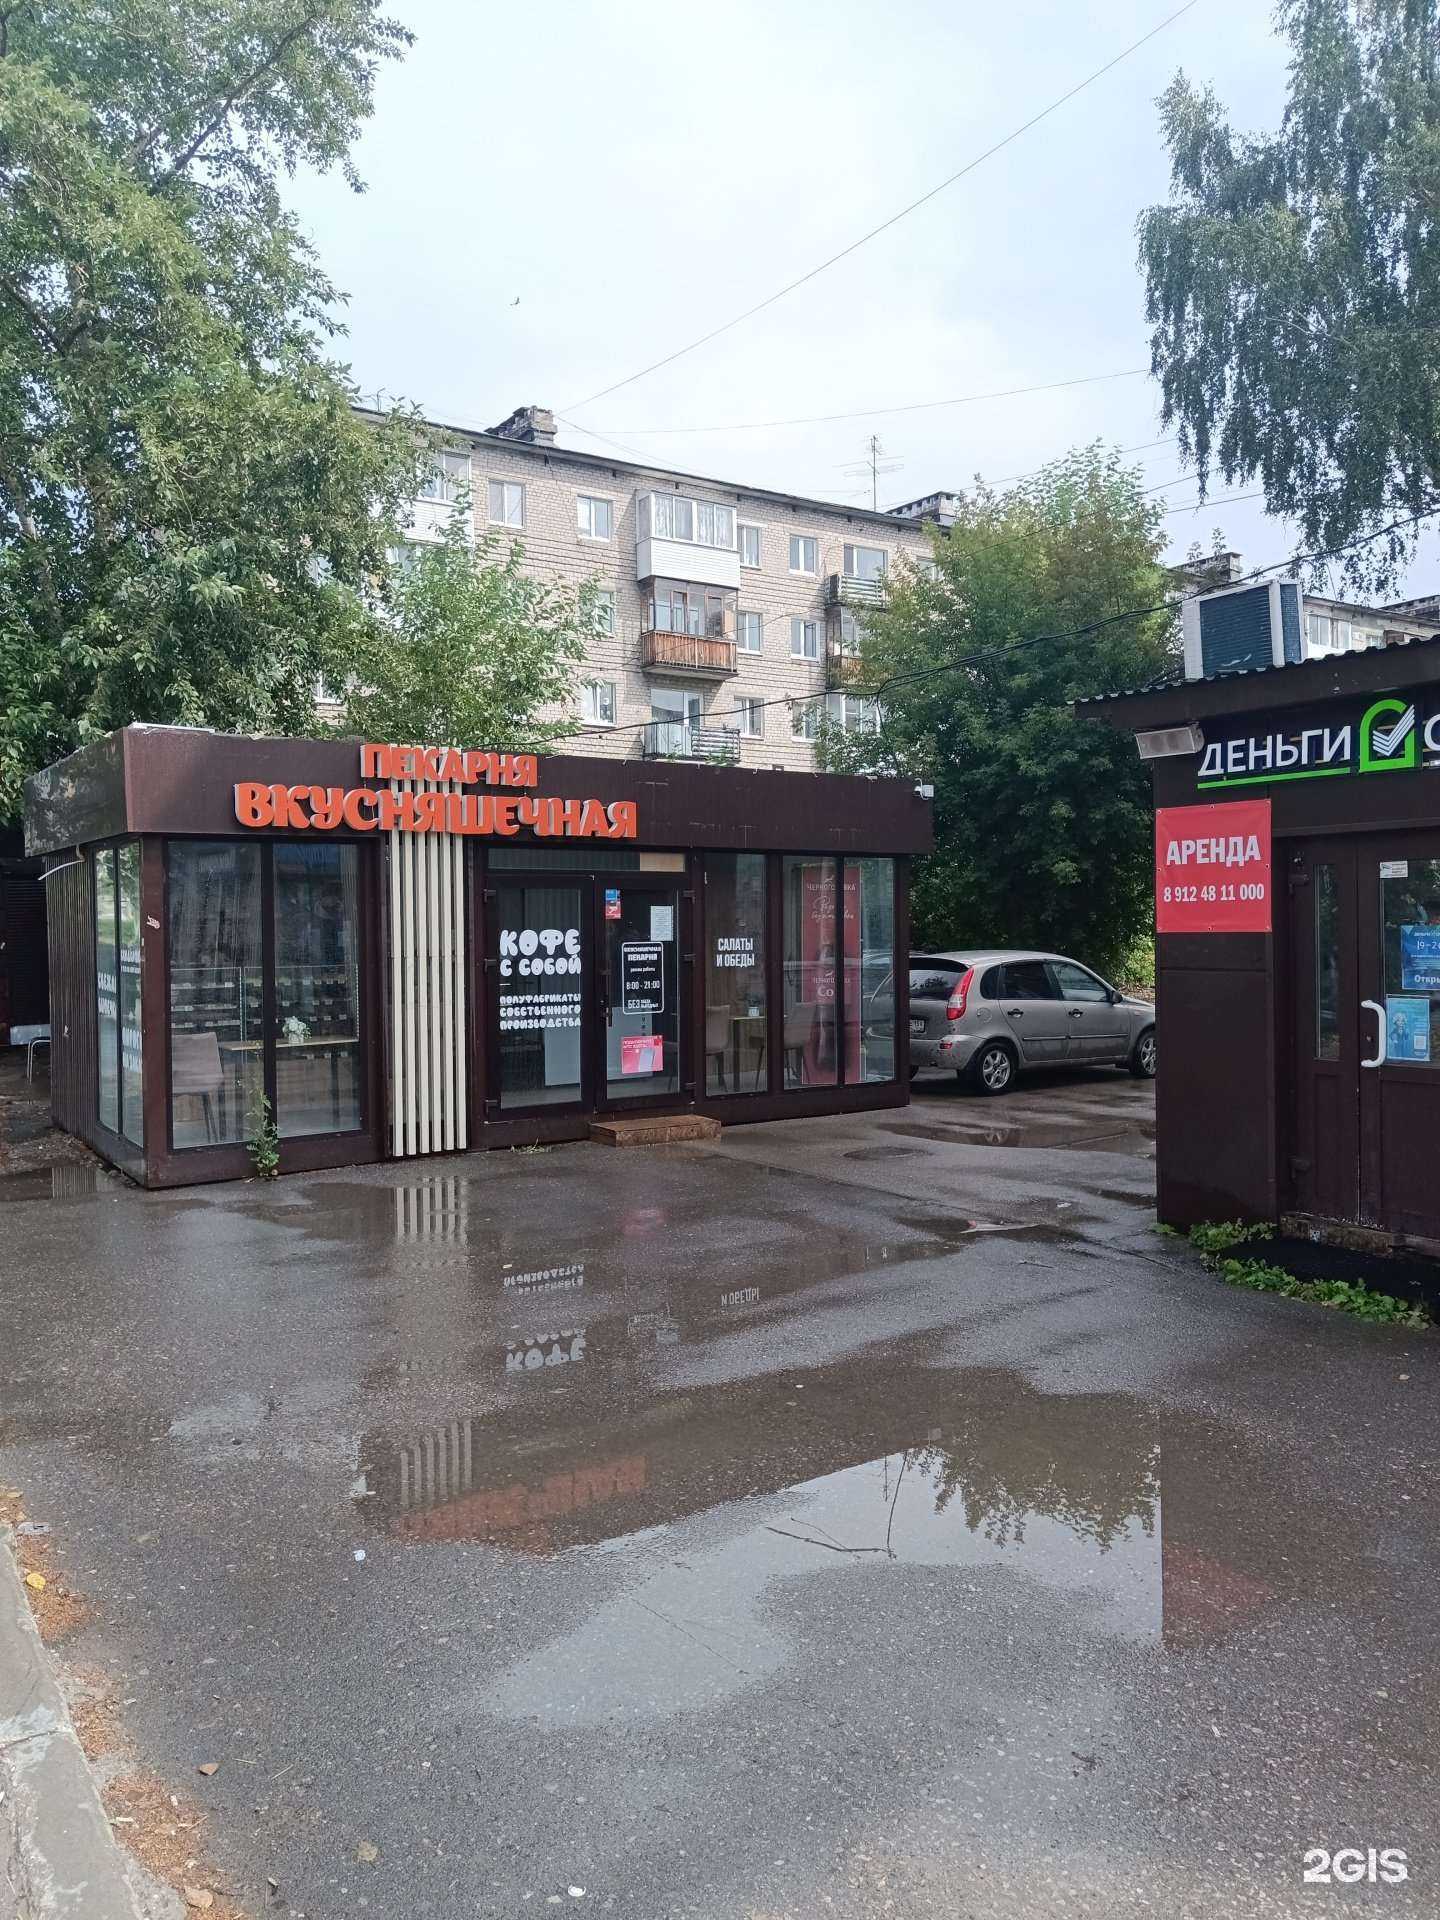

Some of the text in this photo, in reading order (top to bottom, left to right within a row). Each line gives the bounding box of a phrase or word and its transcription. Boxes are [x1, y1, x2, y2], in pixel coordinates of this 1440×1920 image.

[1197, 725, 1352, 777] ДЕНЬГИ
[360, 743, 538, 787] ПЕКАРНЯ
[234, 782, 638, 838] ВКУСНЯШЕЧНАЯ
[1166, 835, 1261, 868] АРЕНДА
[1163, 883, 1265, 903] 8 912 48 11 000
[499, 928, 581, 956] КОФЕ
[718, 937, 754, 951] САЛАТЫ
[500, 954, 582, 977] С СОБОЙ
[716, 953, 755, 968] И ОБЕДЫ
[644, 980, 660, 990] 21:00
[499, 994, 581, 1005] ПОЛУФАБРИКАТЫ
[627, 999, 640, 1009] БЕЗ
[499, 1004, 581, 1017] СОБСТВЕННОГО
[499, 1017, 581, 1030] ПРОИЗВОДСТВА
